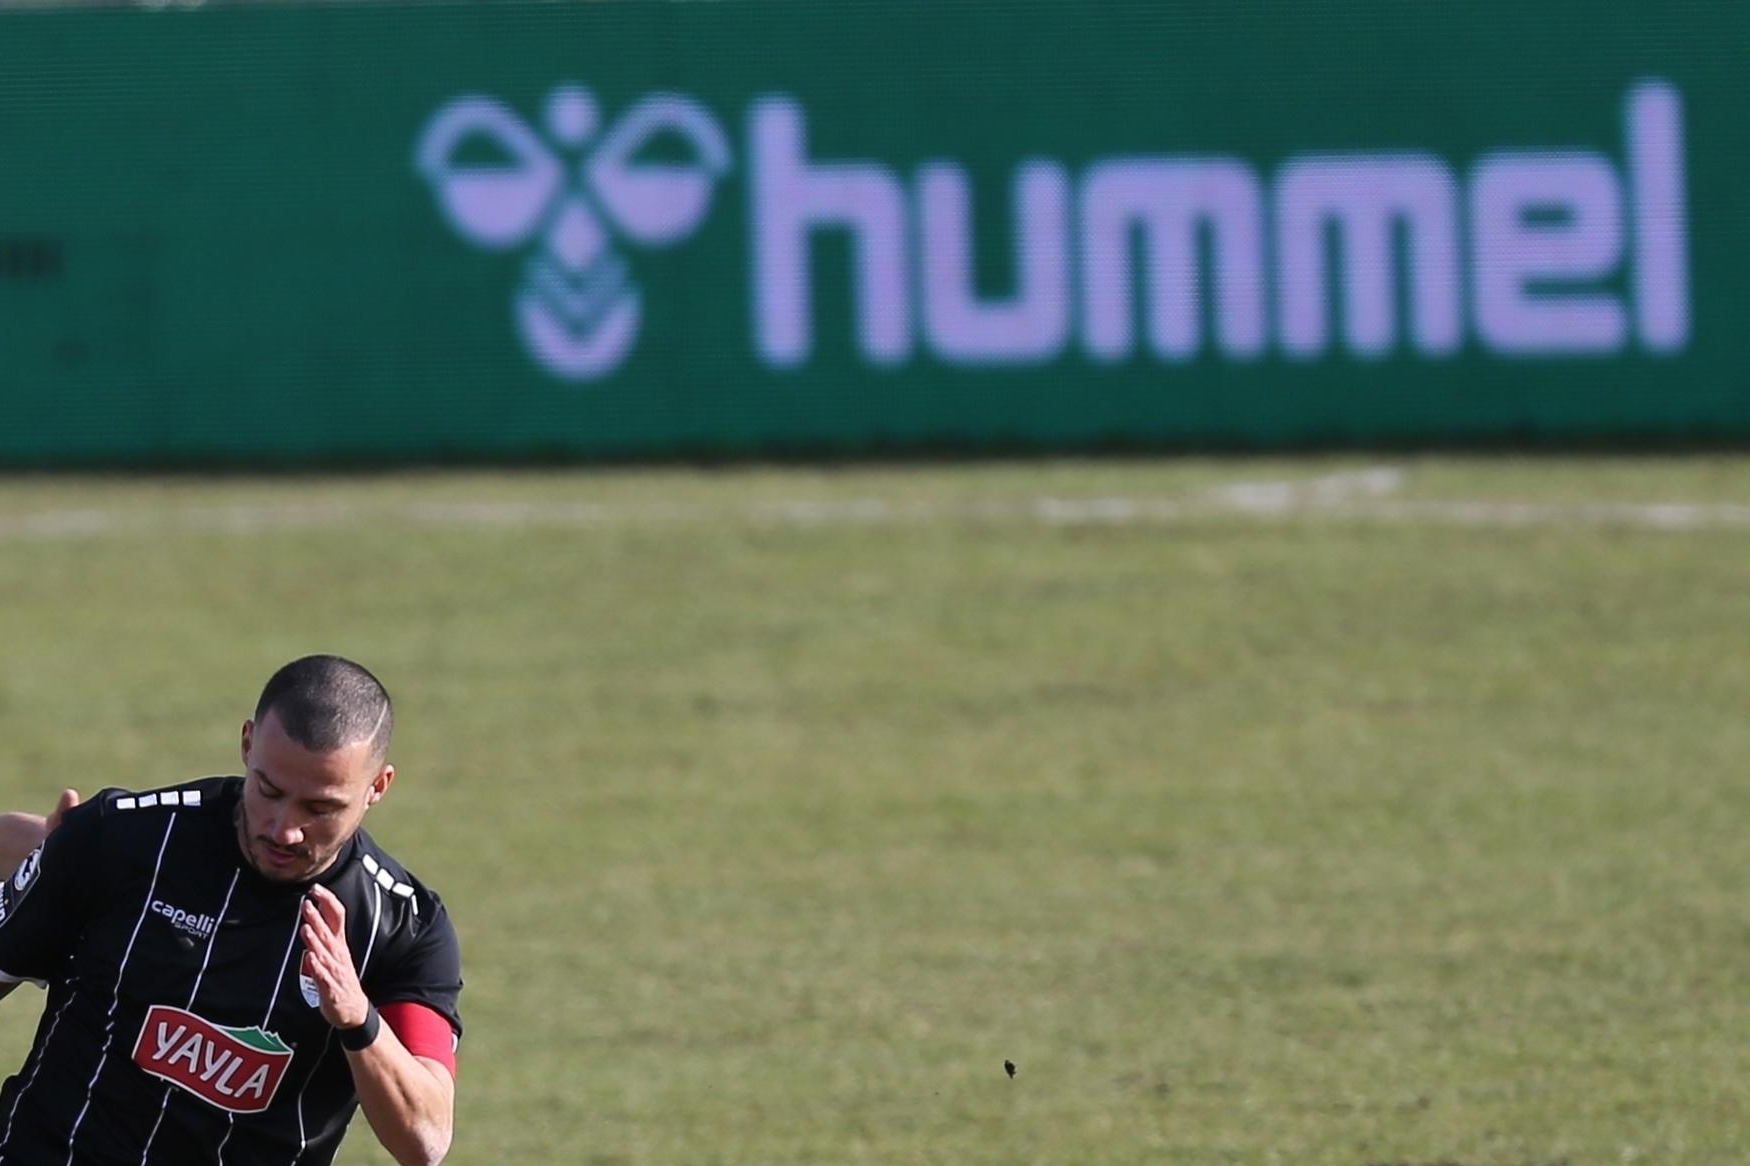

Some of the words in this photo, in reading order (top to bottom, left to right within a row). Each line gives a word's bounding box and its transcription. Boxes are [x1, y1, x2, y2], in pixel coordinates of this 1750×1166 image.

[753, 81, 1688, 364] hummel
[151, 900, 215, 934] capelli
[152, 1021, 270, 1099] YAYLA
